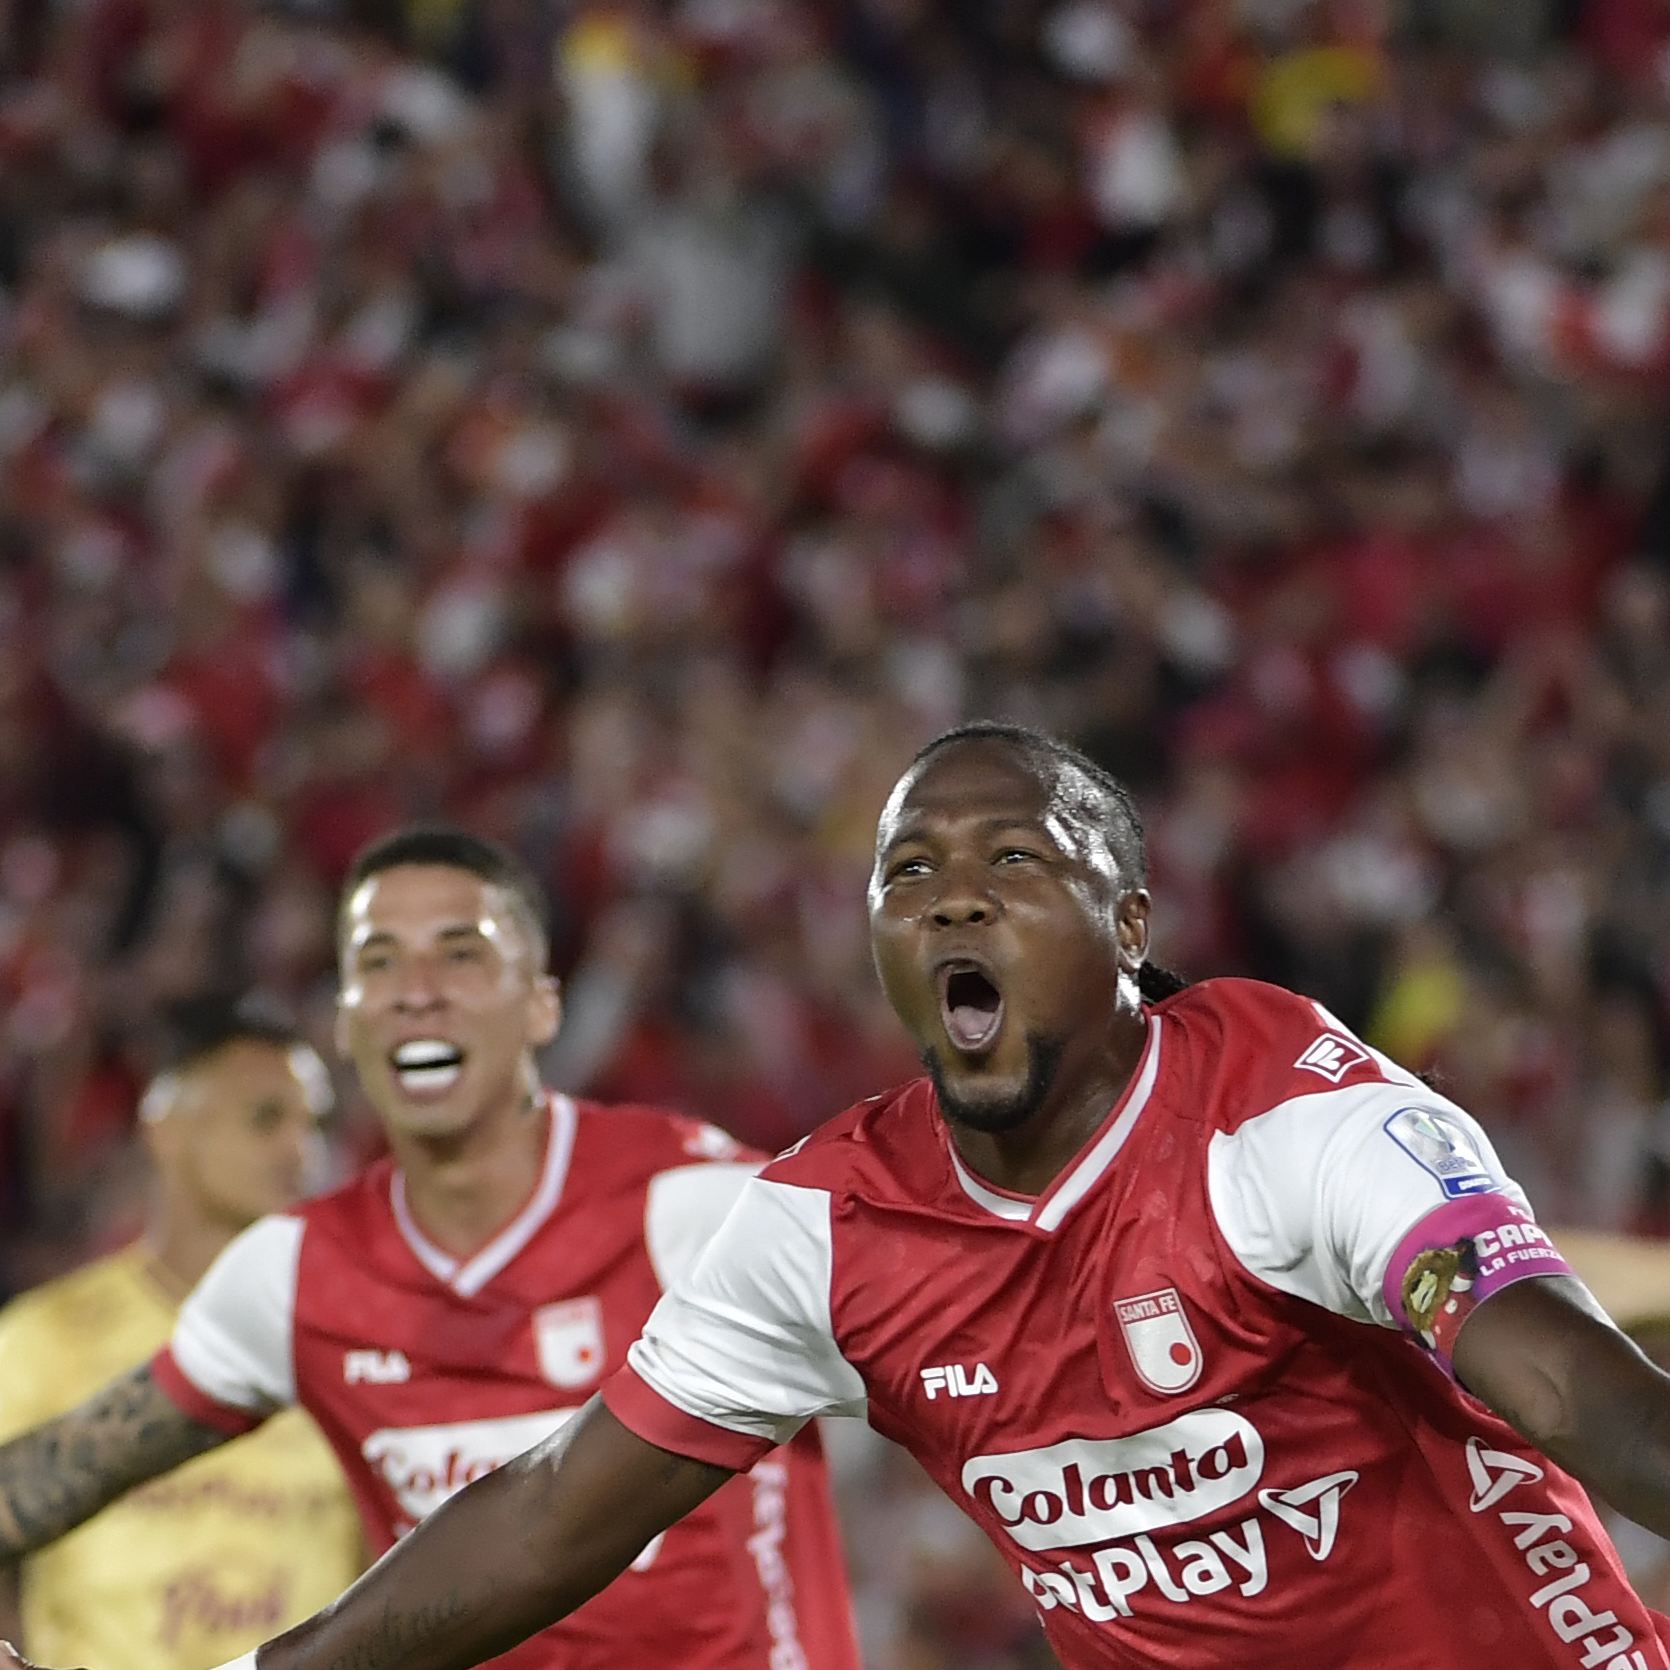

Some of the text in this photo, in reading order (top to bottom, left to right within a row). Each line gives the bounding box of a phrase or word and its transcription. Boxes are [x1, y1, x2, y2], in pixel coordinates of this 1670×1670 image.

[1479, 1259, 1506, 1276] LA
[1120, 1293, 1178, 1322] SANTA FE
[920, 1362, 999, 1400] FILA
[973, 1420, 1248, 1527] Colanta
